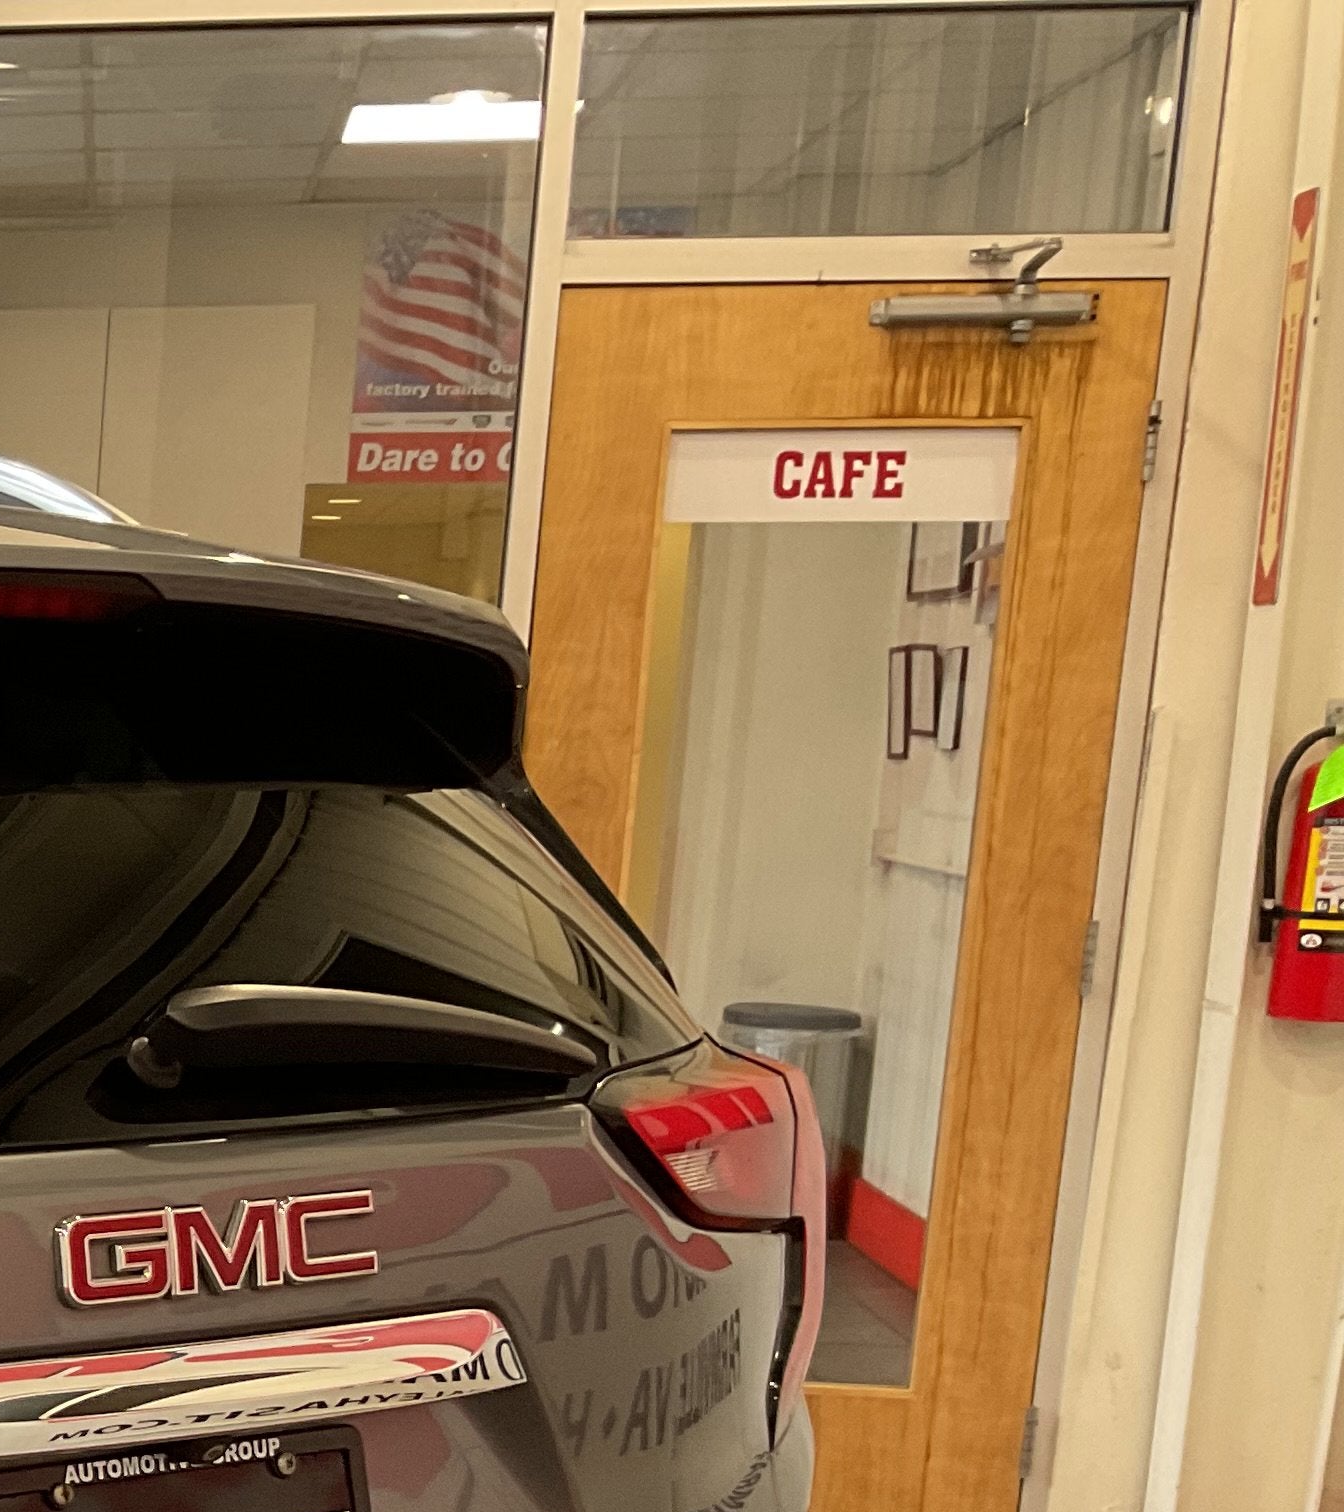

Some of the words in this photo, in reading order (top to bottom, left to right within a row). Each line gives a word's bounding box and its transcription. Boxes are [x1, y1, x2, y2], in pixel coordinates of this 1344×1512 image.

[366, 382, 431, 399] factory
[357, 443, 439, 472] Dare
[451, 443, 486, 472] to
[773, 449, 908, 500] CAFE
[54, 1190, 379, 1309] GMC
